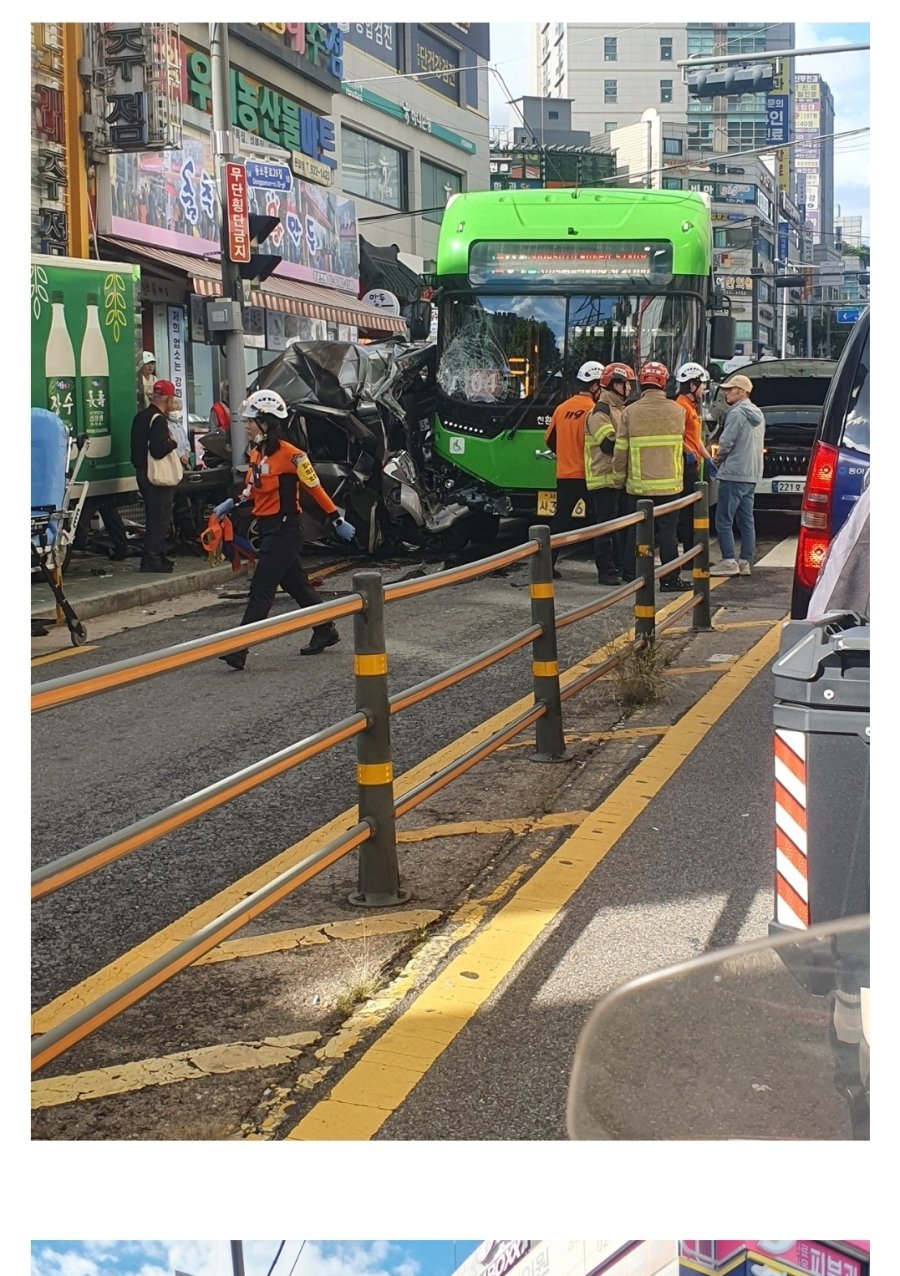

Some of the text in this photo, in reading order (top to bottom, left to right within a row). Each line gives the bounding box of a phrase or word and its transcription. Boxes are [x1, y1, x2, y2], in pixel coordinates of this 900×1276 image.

[188, 51, 337, 170] 우농산물마트
[231, 167, 246, 258] 무단횡단금지
[172, 311, 180, 333] 저희
[173, 337, 182, 372] 업소는
[565, 409, 586, 421] 119
